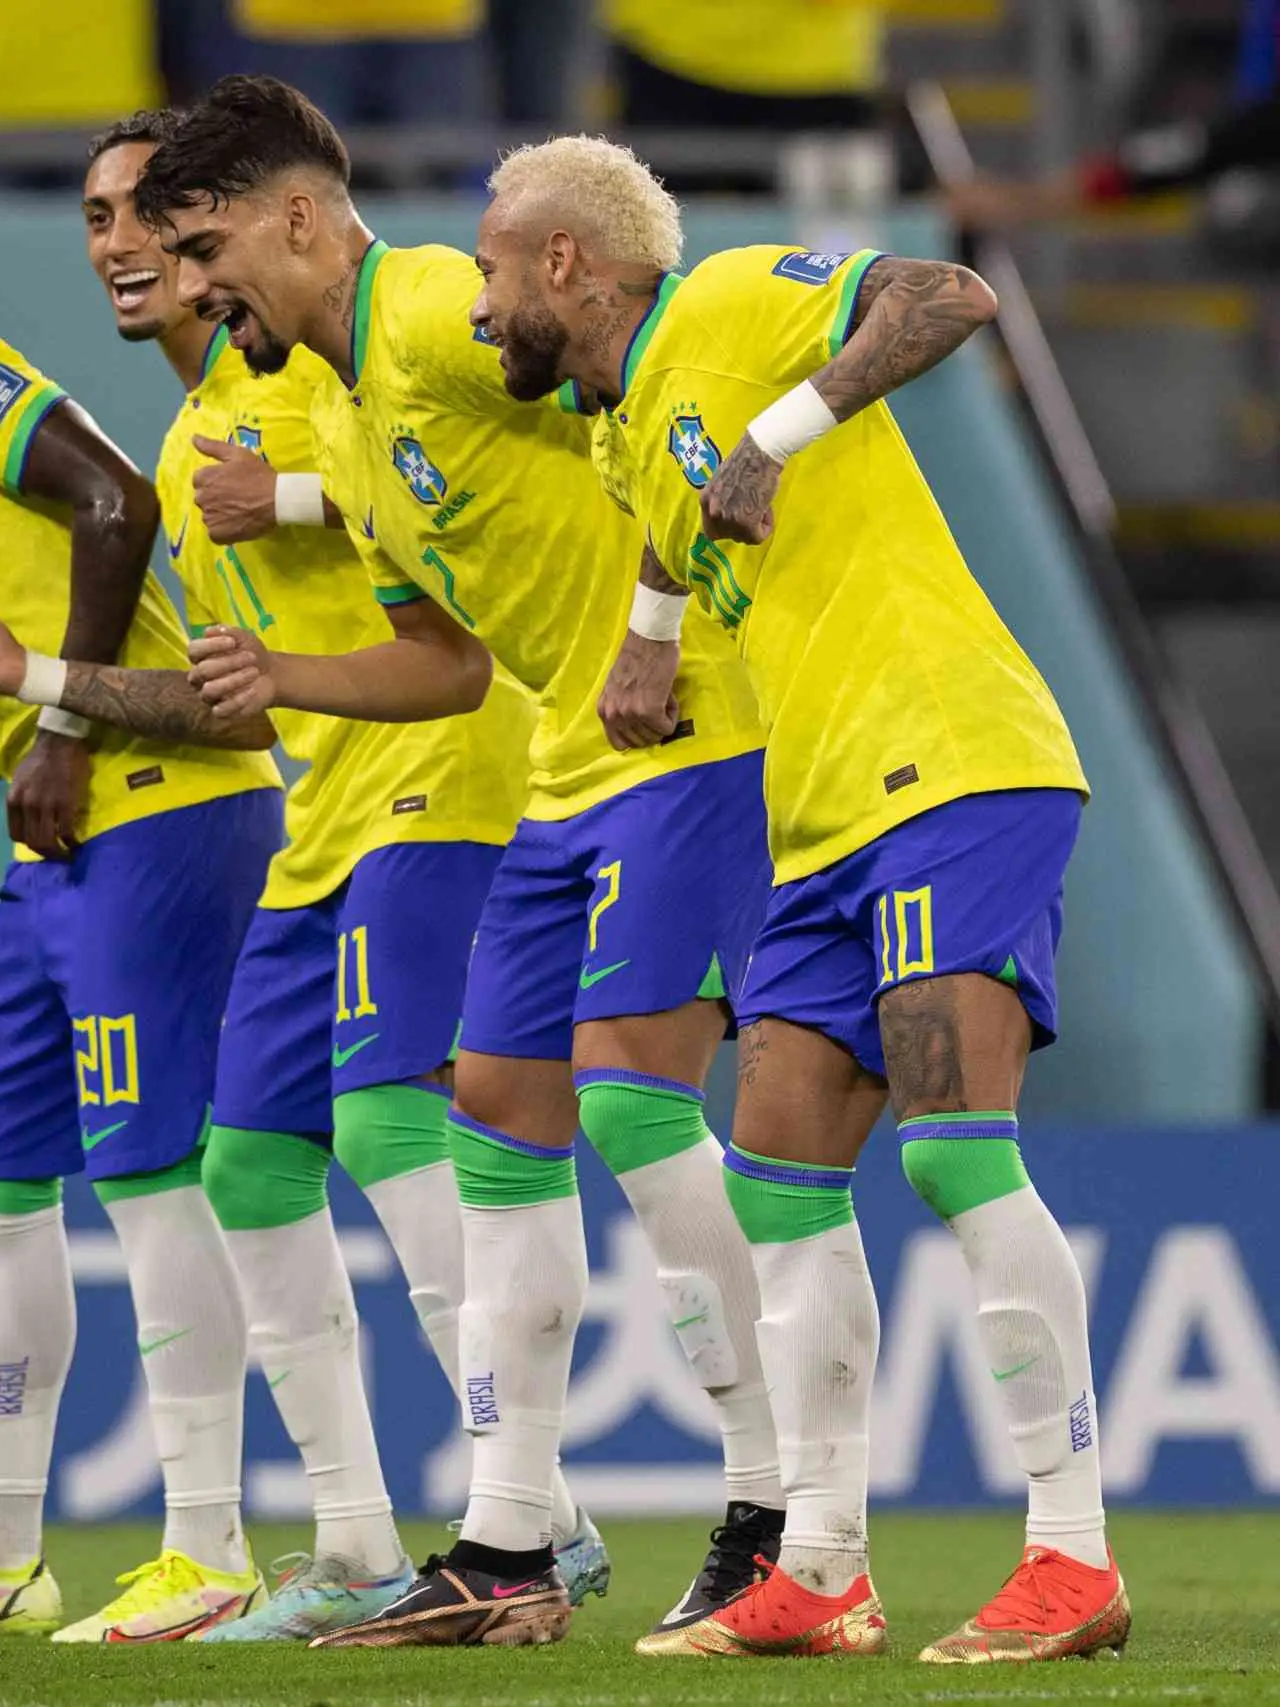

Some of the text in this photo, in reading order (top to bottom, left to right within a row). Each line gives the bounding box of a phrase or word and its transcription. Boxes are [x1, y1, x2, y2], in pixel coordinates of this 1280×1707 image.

[684, 442, 699, 461] CBF
[431, 491, 477, 531] BRASIL
[688, 532, 753, 628] 10
[590, 859, 622, 953] 7
[879, 884, 934, 986] 10
[336, 925, 378, 1025] 11
[72, 1013, 140, 1107] 20
[467, 1371, 500, 1425] BRASIL
[1069, 1389, 1092, 1453] BRASIL
